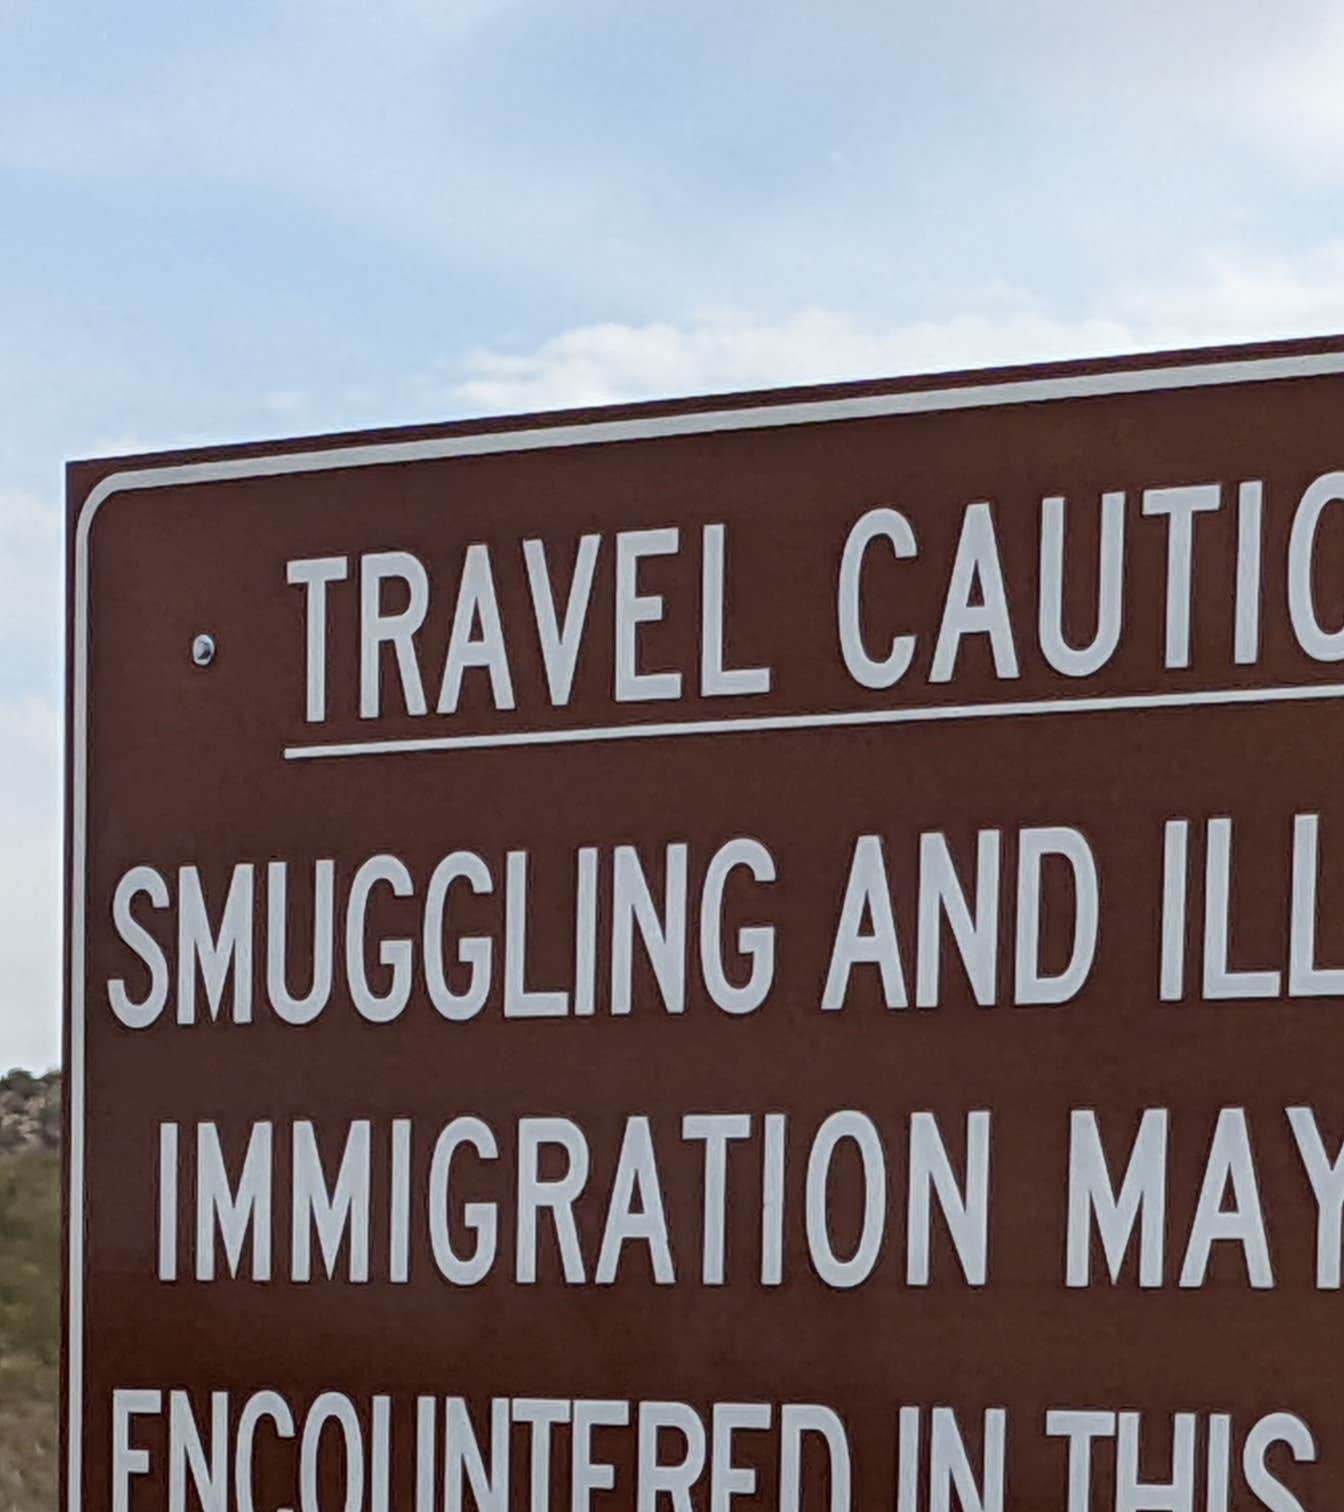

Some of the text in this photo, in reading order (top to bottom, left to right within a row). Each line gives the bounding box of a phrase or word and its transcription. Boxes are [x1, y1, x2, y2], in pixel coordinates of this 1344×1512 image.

[287, 523, 770, 722] TRAVEL
[107, 838, 776, 1028] SMUGGLING
[821, 826, 1099, 1010] AND
[159, 1110, 991, 1288] IMMIGRATION
